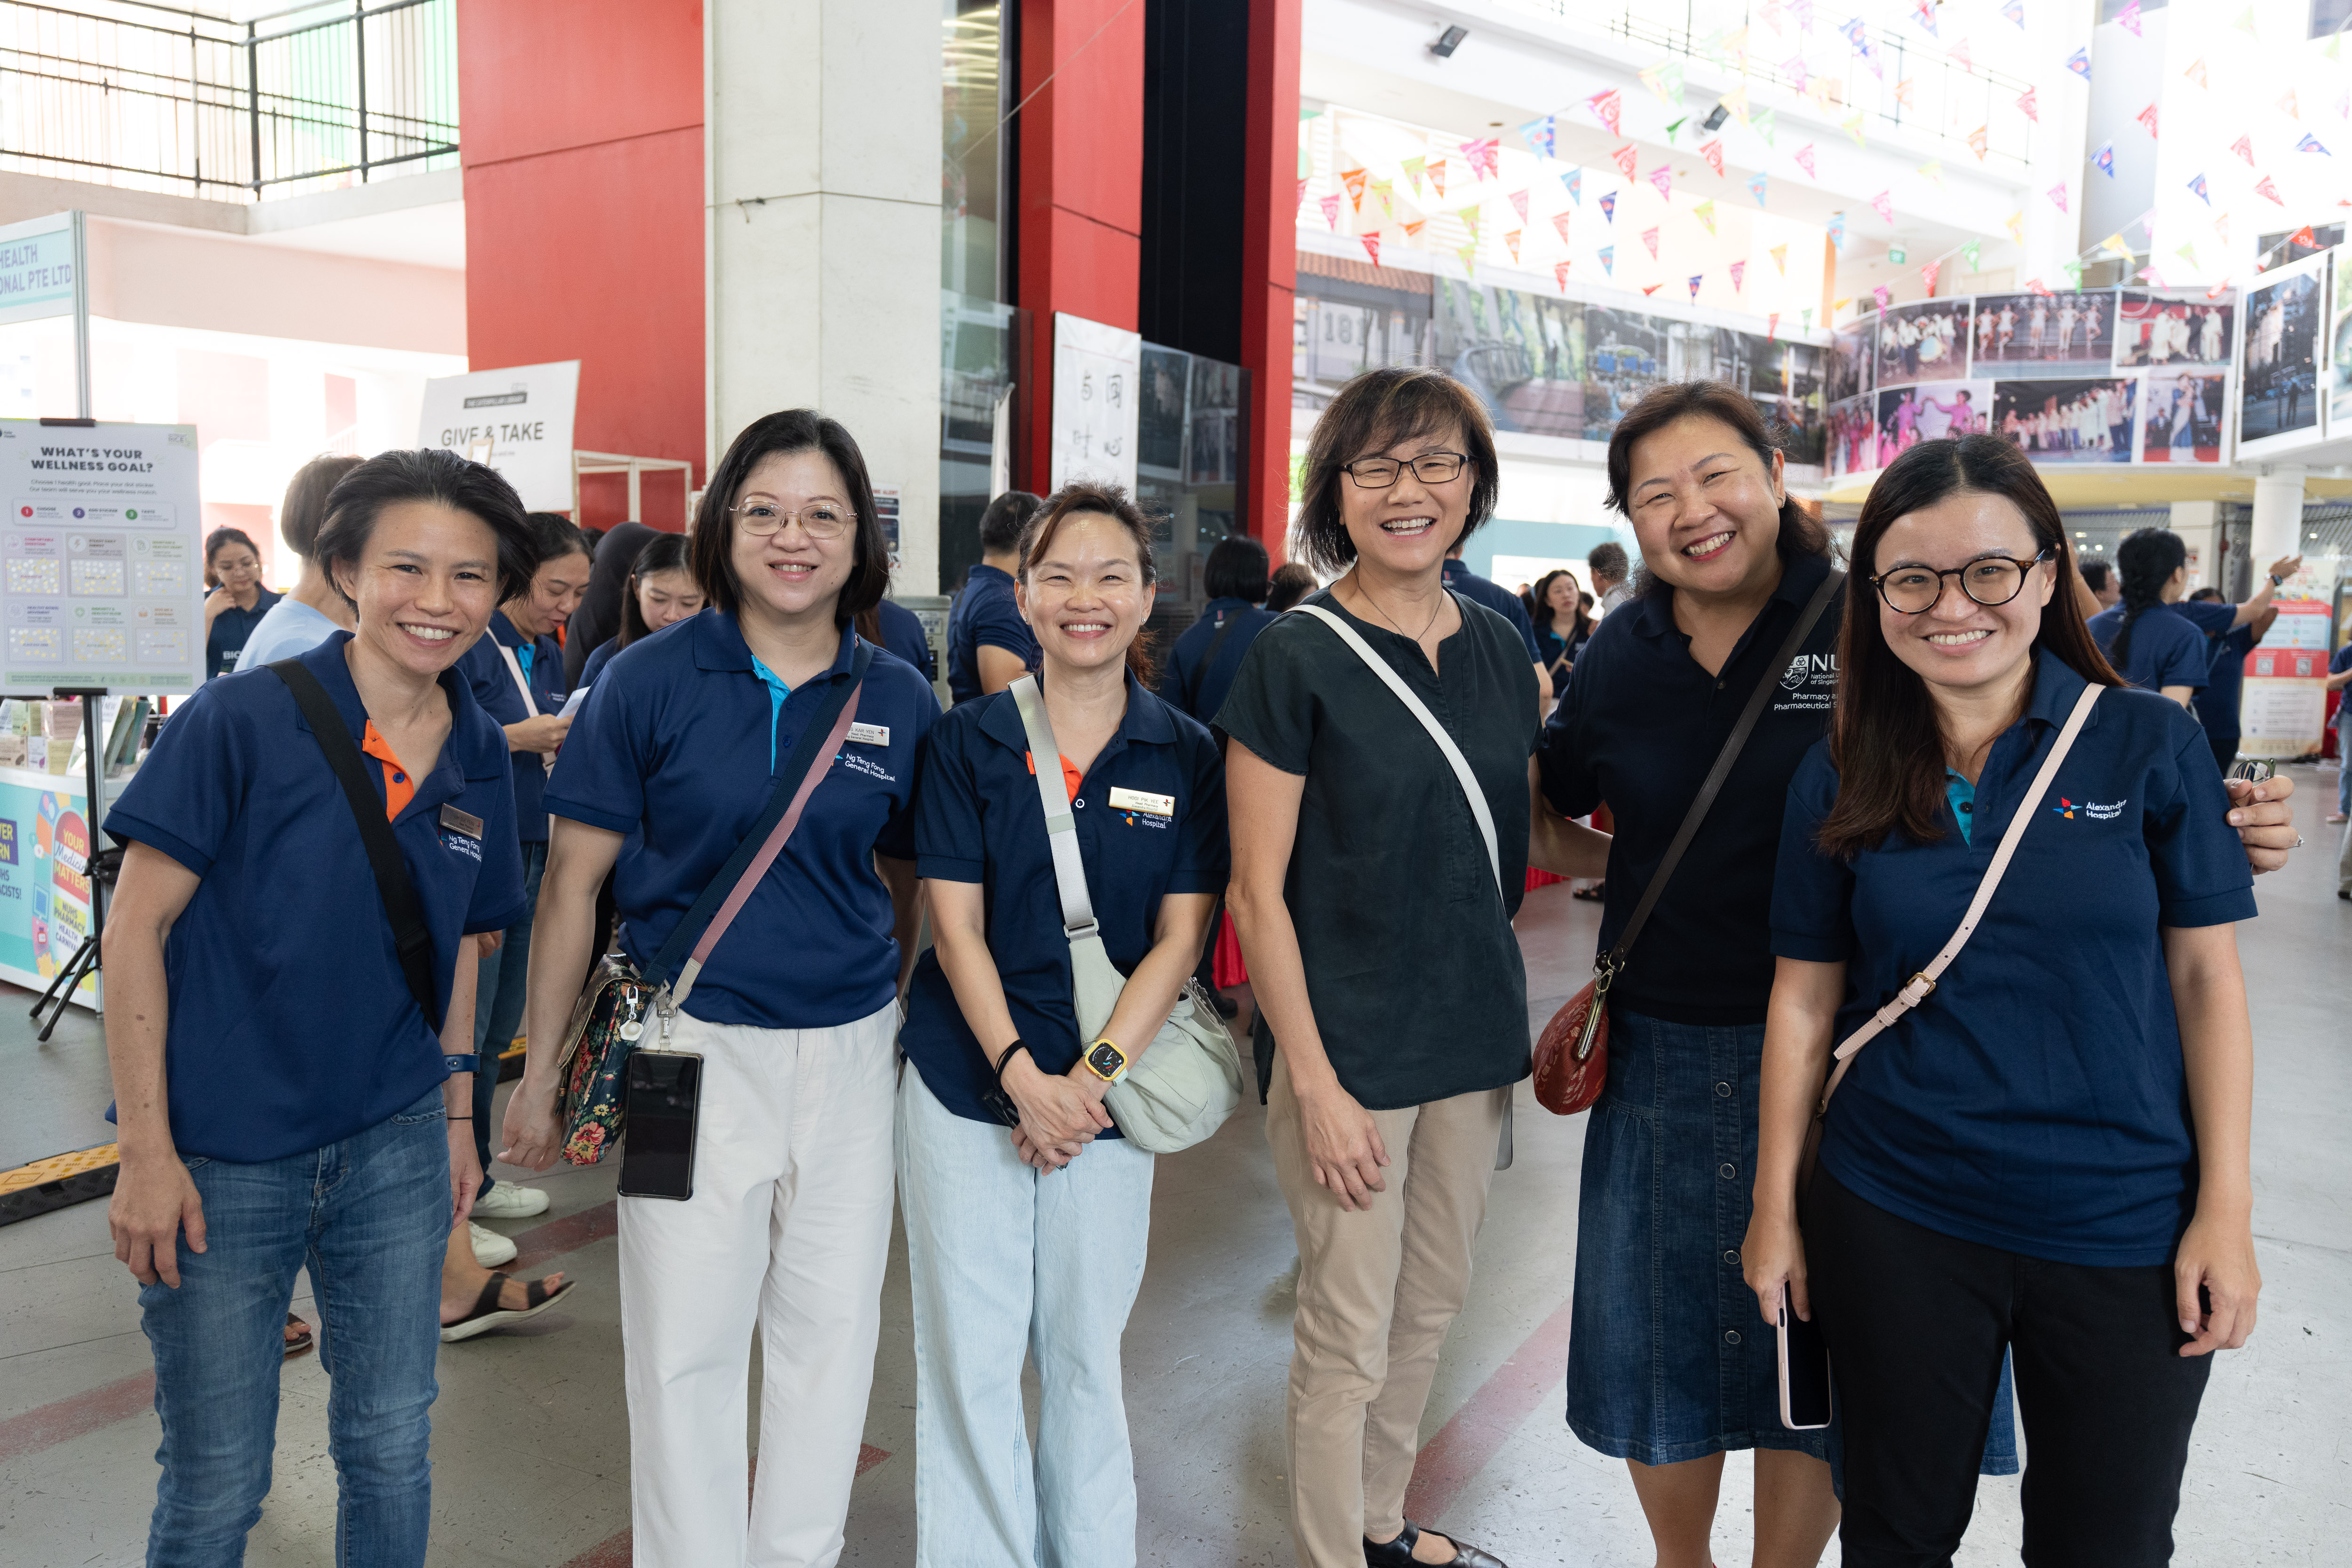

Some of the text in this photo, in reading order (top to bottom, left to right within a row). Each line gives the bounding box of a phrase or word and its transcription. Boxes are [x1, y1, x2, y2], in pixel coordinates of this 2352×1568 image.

[28, 267, 48, 290] PTE
[52, 263, 71, 286] LTD
[441, 426, 478, 446] GIVE
[501, 422, 544, 442] TAKE
[40, 446, 142, 459] WHAT'S YOUR
[31, 460, 153, 472] WELLNESS GOAL?
[1812, 654, 1840, 671] NU
[1774, 702, 1831, 710] Pharmaceutical
[845, 761, 895, 781] General Hospital
[846, 753, 884, 774] Ng Teng Fong
[1143, 812, 1171, 822] Alexandra
[2086, 808, 2121, 819] Hospital
[1142, 819, 1166, 828] Hospital
[63, 829, 84, 854] YOUR
[449, 835, 480, 853] Ng Teng Fong
[55, 843, 85, 871] Medicin
[449, 843, 482, 862] General Hospit
[0, 868, 9, 881] HS
[54, 860, 90, 895] MATTERS
[63, 902, 78, 919] NUHS
[54, 907, 85, 934] PHARMACY
[59, 923, 78, 941] HEALTH
